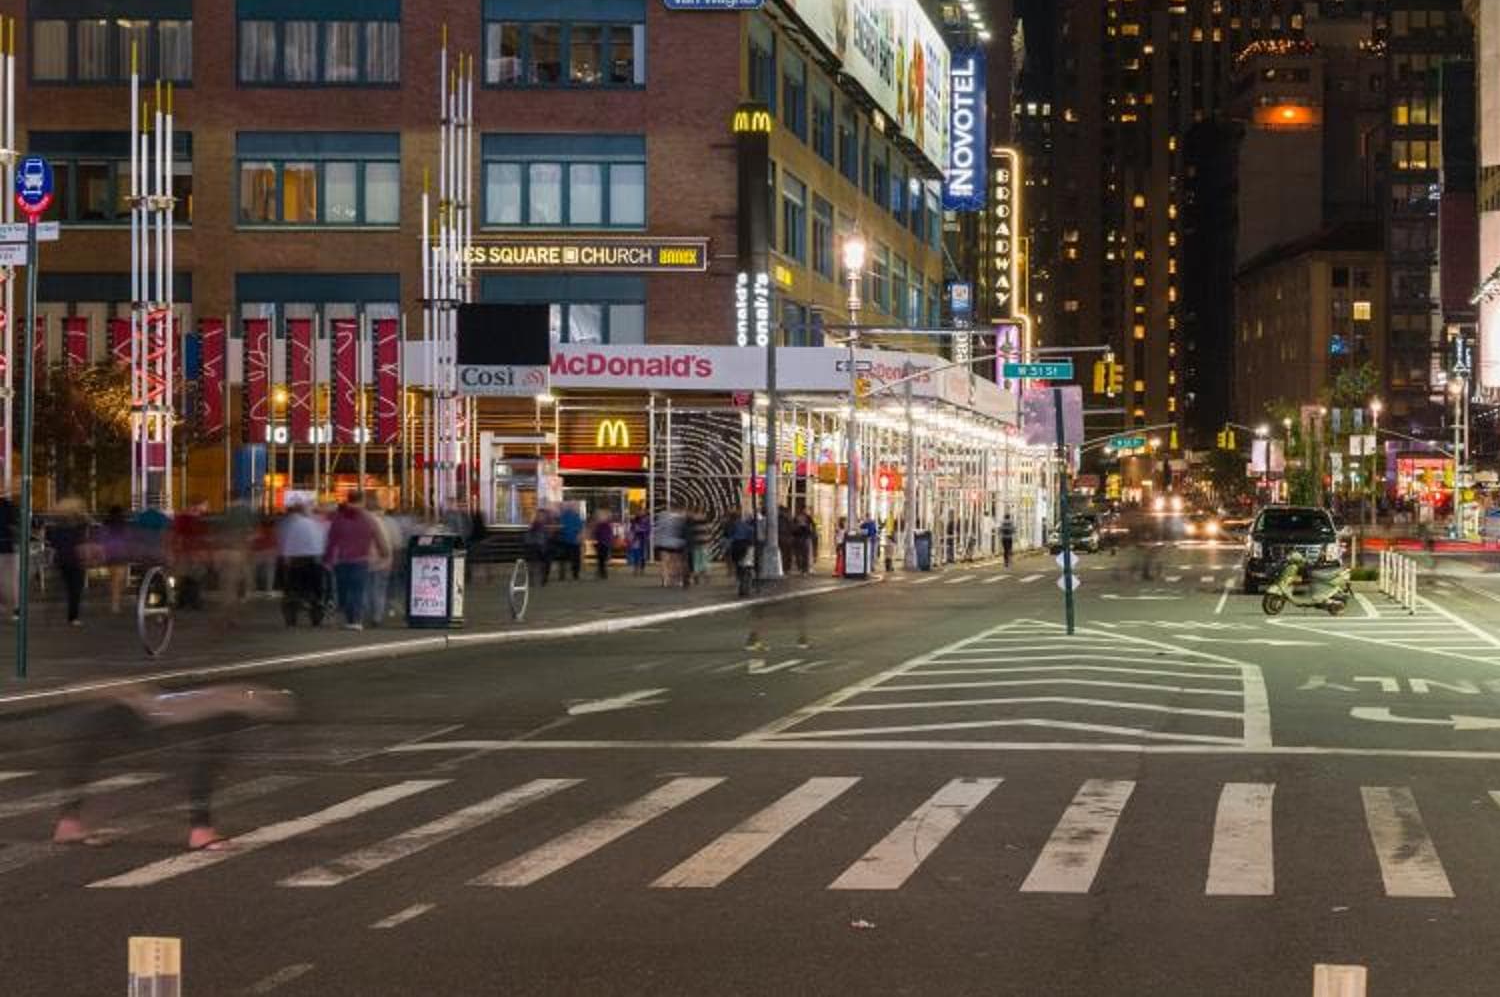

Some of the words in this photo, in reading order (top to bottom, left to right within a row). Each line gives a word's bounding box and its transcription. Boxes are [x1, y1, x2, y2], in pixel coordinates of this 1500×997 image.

[949, 58, 975, 197] NOVOTEL
[431, 246, 486, 264] TES
[489, 246, 560, 265] SQUARE
[580, 248, 652, 265] CHURCH
[995, 168, 1011, 306] BROADWAY
[550, 353, 712, 378] McDonald's
